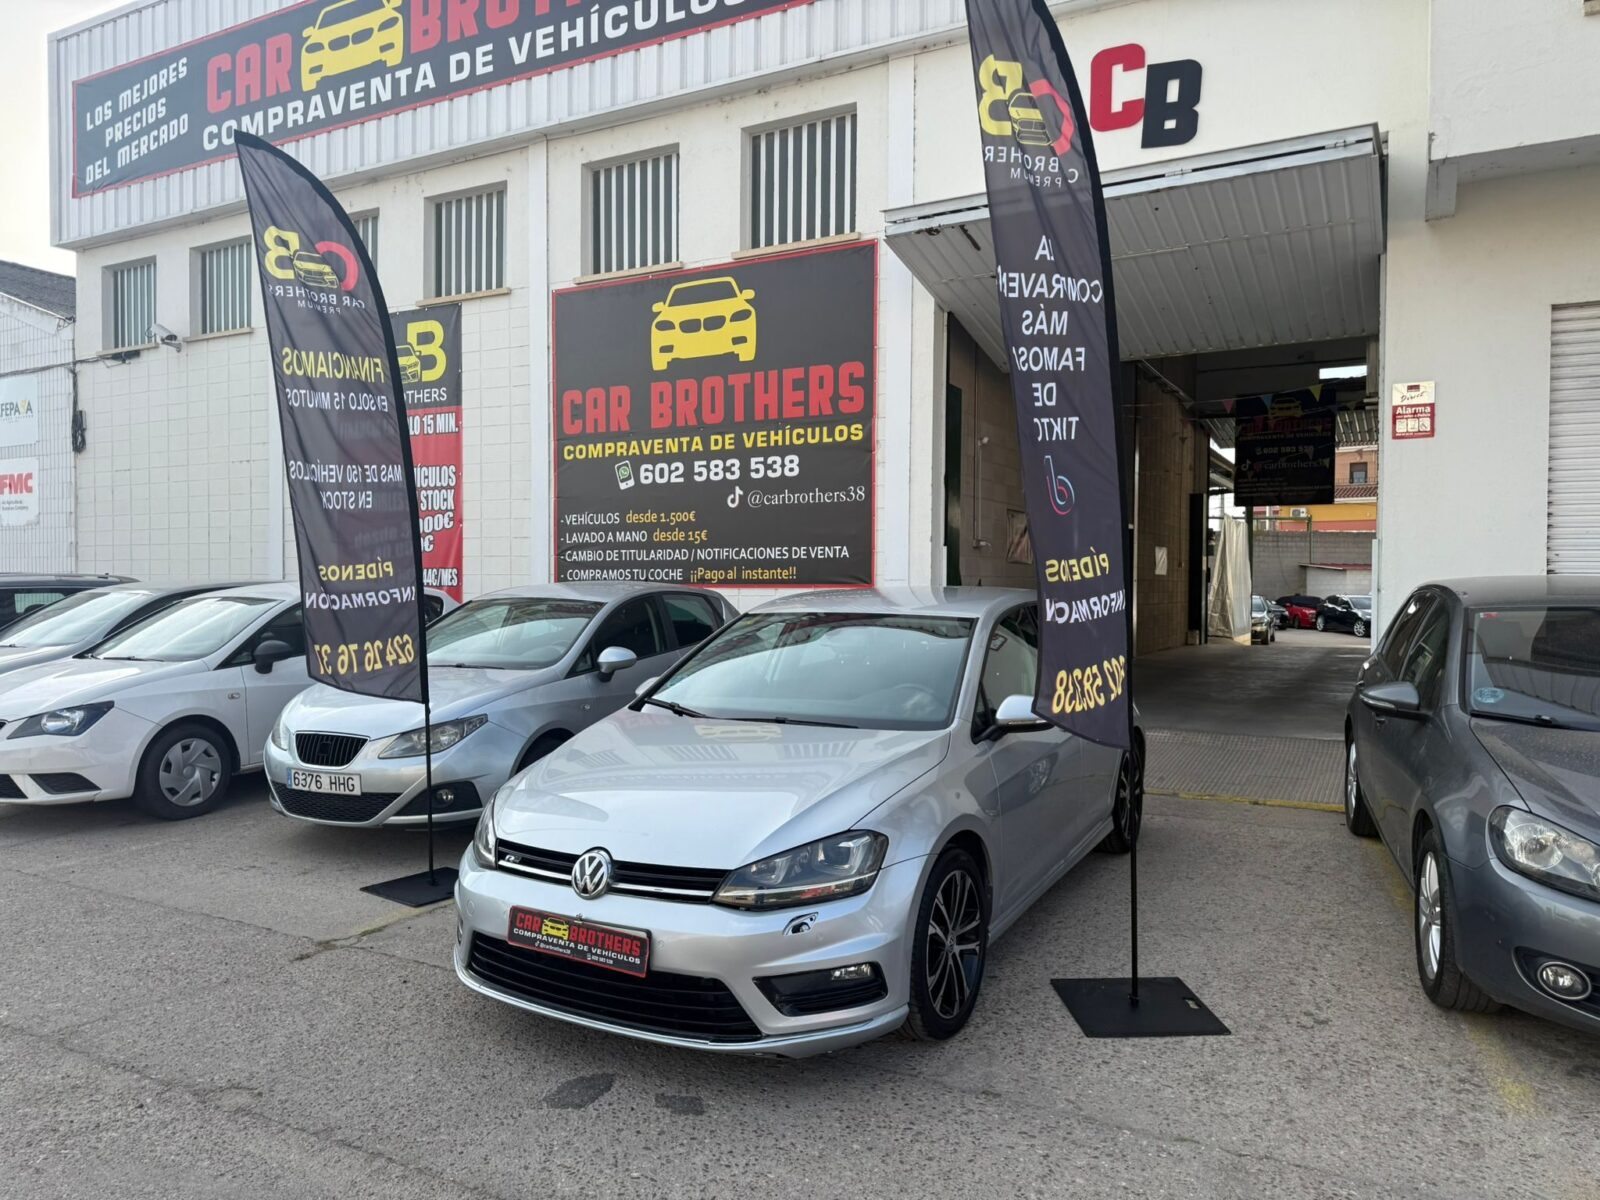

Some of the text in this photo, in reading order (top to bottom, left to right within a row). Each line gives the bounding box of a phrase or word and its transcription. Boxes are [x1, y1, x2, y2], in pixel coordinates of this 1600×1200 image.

[203, 0, 747, 151] COMPRAVENTA DE VEHÍCUL
[207, 32, 293, 114] CAR
[86, 56, 188, 132] LOS MEJORES
[105, 97, 167, 147] PRECIOS
[86, 113, 189, 185] DEL MERCADO
[562, 361, 865, 435] CAR BROTHERS
[1396, 405, 1430, 414] Alarma
[422, 414, 434, 434] 15
[436, 412, 459, 433] MIN.
[563, 424, 864, 460] COMPRAVENTA DE VEHÍCULOS
[639, 455, 800, 484] 602 583 538
[420, 490, 455, 511] STOCK
[747, 485, 866, 508] @carbrothers38
[565, 509, 696, 526] VEHÍCULOS desde 1.500€
[566, 528, 708, 544] LAVADO A MANO desde 15€
[565, 550, 604, 562] CAMBIO
[606, 550, 620, 561] DE
[621, 549, 689, 561] TITULARIDAD
[697, 547, 789, 560] NOTIFICACIONES
[792, 547, 807, 559] DE
[809, 546, 850, 559] VENTA
[567, 566, 797, 583] COMPRAMOS TU COCHE ¡¡Pago al instante!!
[293, 772, 355, 792] 6376 HHG
[513, 928, 575, 949] COMPRAVENTA
[577, 944, 589, 952] DE
[591, 948, 641, 964] VEHÍCULOS
[516, 912, 641, 957] CAR BROTHERS
